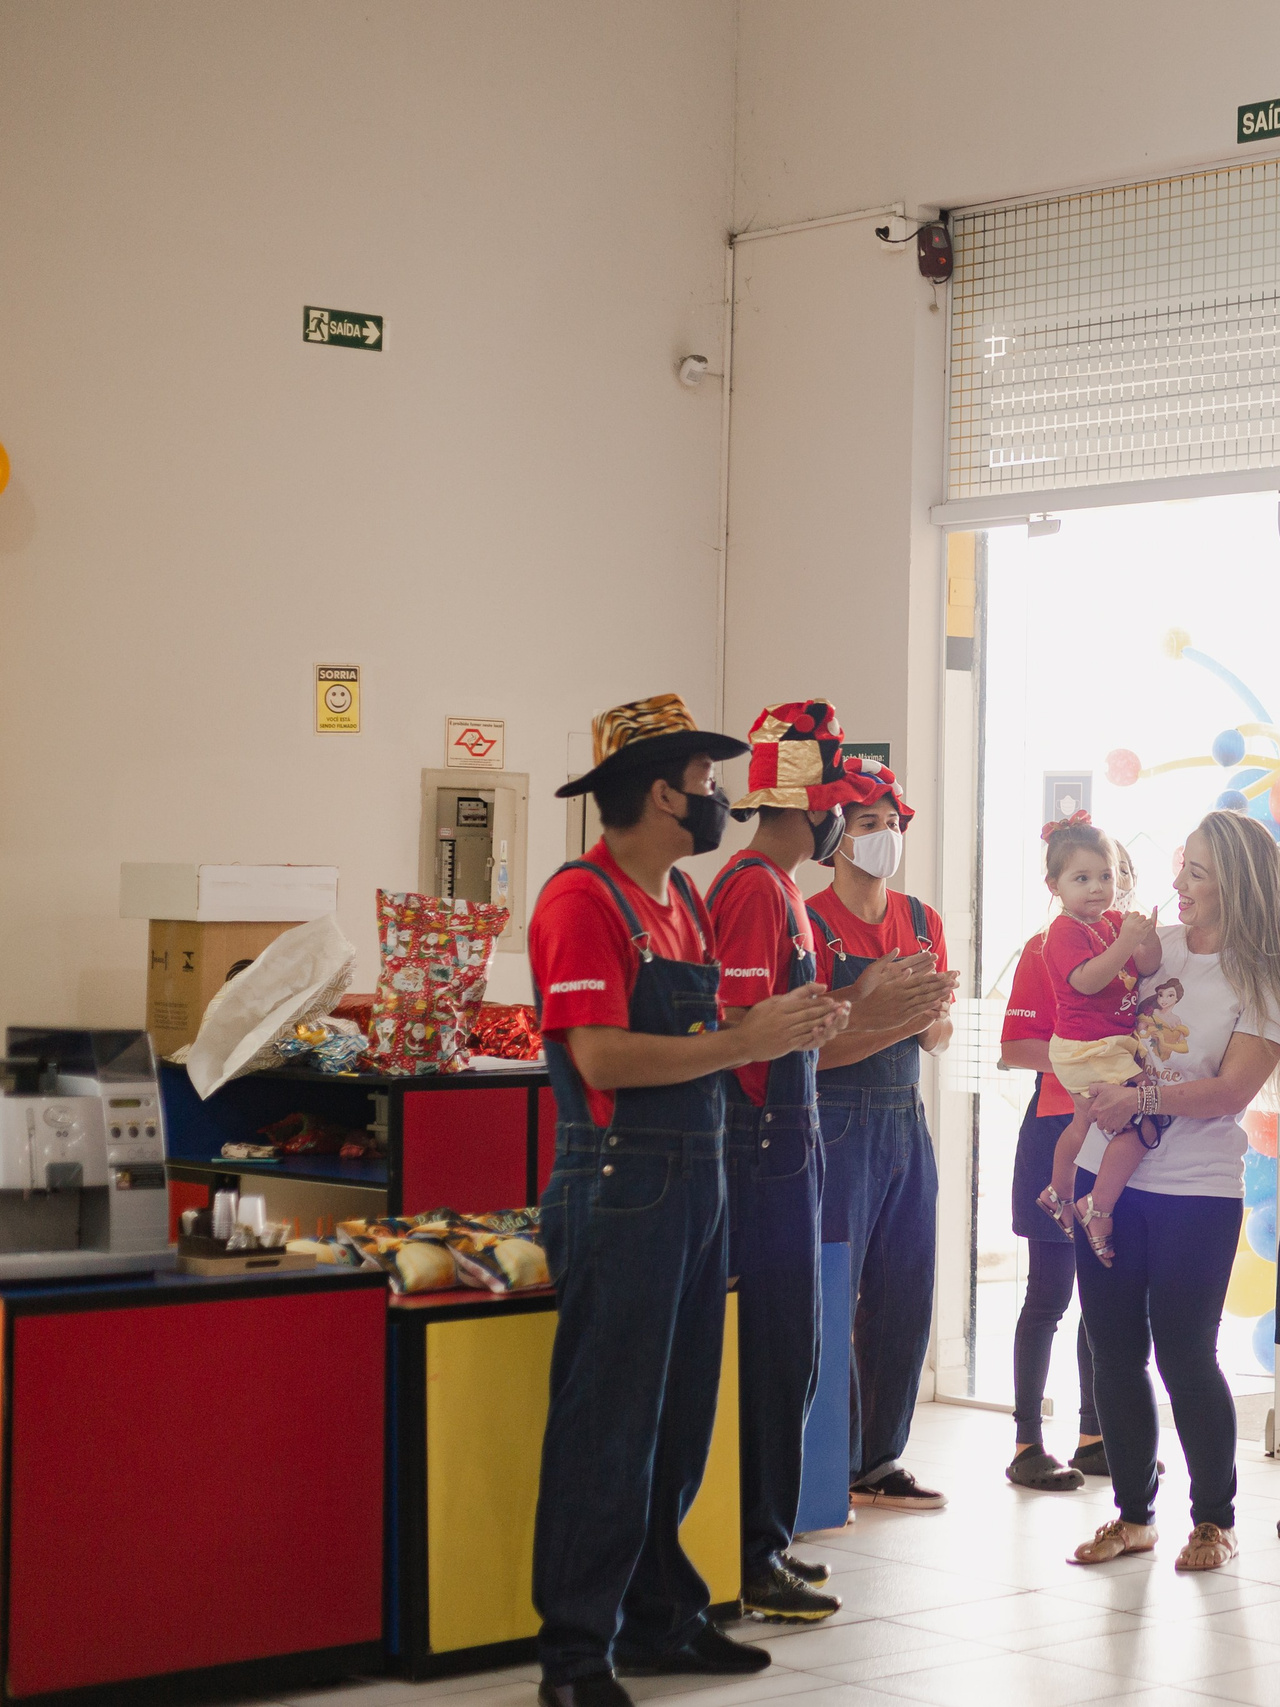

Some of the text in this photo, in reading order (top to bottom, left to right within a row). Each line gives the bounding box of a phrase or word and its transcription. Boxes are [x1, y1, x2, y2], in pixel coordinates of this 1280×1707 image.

[329, 319, 361, 338] SAÍDA
[320, 669, 357, 680] SORRIA
[725, 967, 770, 978] MONITOR
[550, 979, 606, 994] MONITOR
[1006, 1008, 1037, 1019] ONITOR
